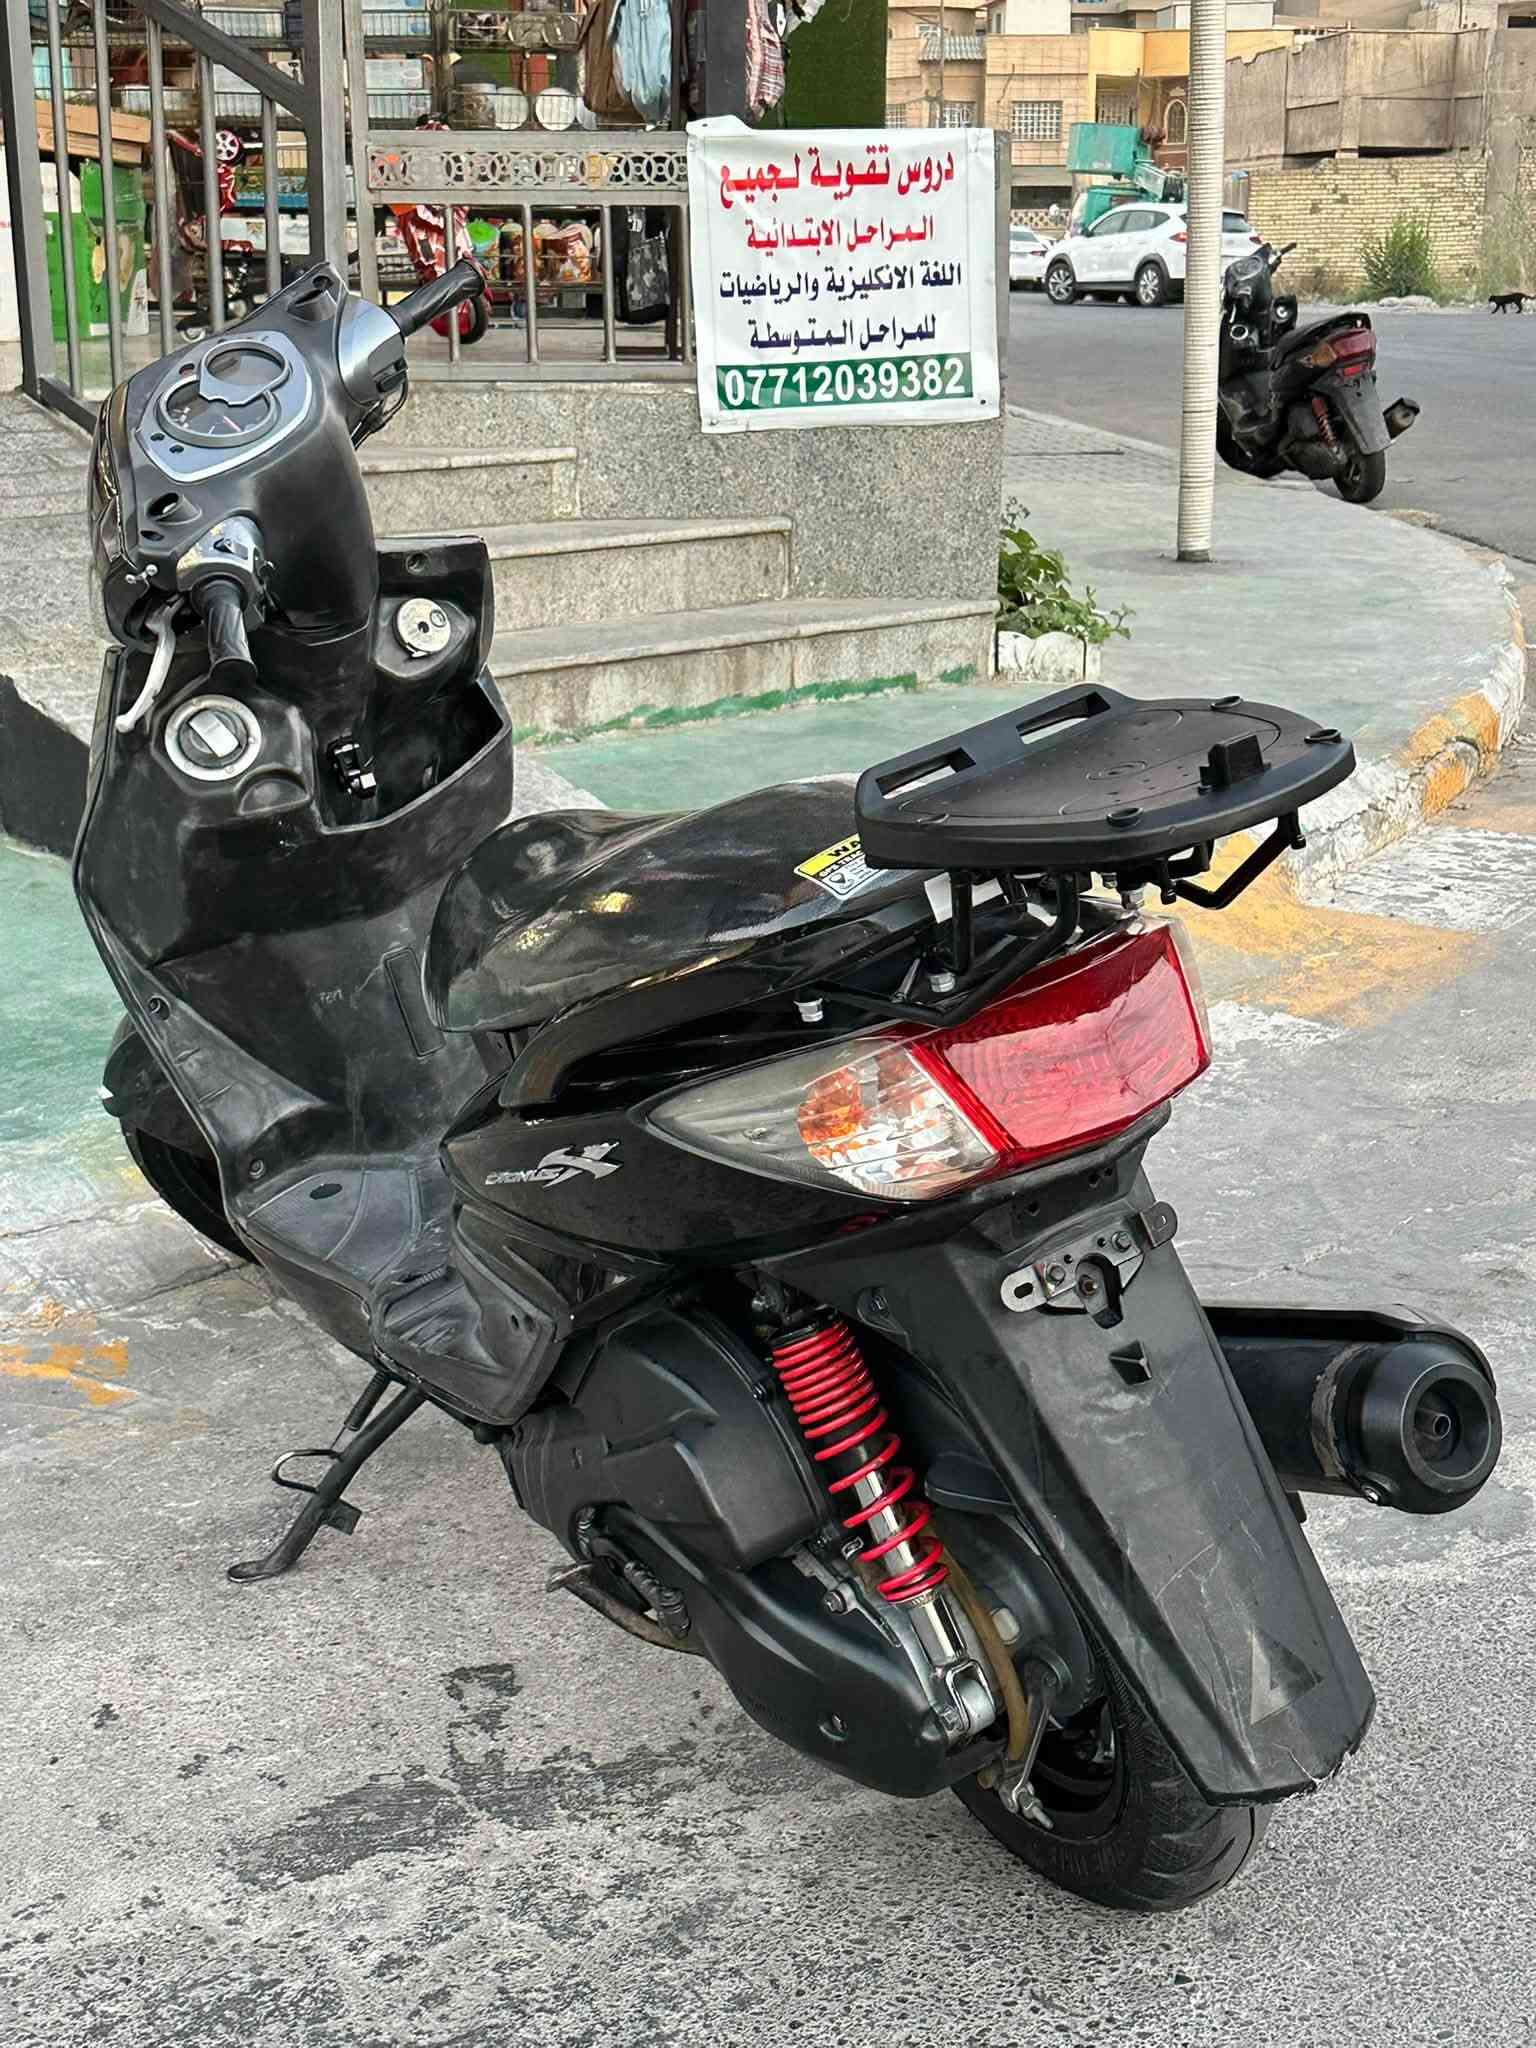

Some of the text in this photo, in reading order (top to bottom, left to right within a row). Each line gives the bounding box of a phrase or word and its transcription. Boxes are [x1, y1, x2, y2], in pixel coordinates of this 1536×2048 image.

[720, 144, 955, 209] دروس تقوية لجميع
[744, 215, 935, 256] المراحل الابتدائية
[719, 260, 962, 304] اللغة الانكليزية والرياضيات
[748, 313, 937, 355] للمراحل المتوسطة
[724, 357, 966, 407] 07712039382
